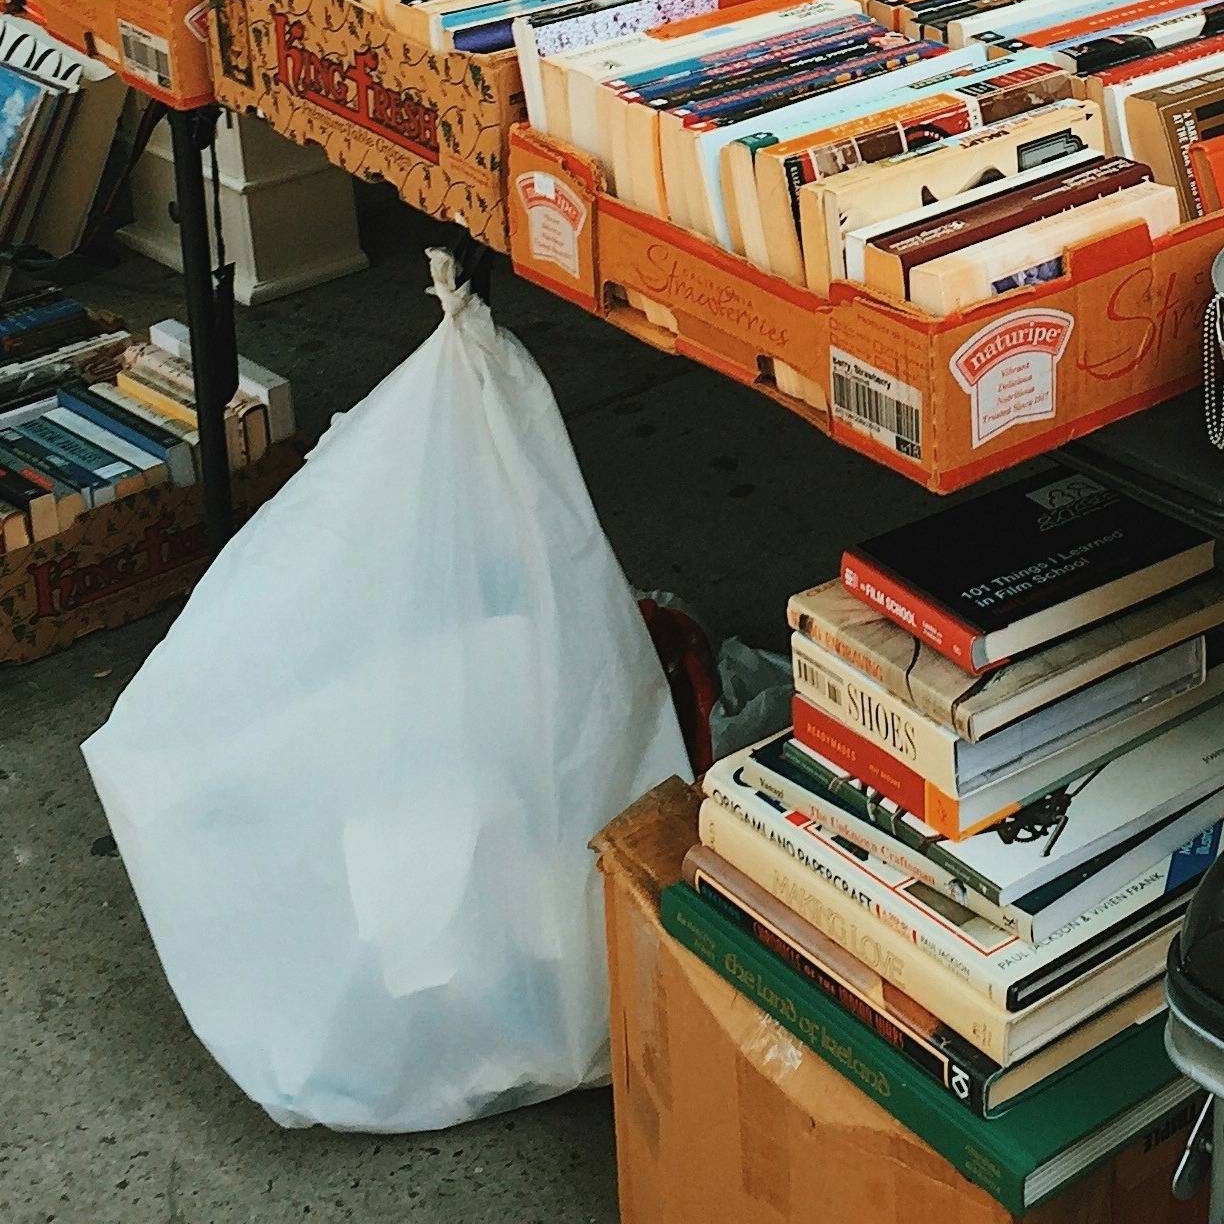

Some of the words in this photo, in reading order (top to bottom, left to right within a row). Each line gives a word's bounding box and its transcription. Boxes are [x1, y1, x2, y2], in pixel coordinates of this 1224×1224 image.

[970, 321, 1062, 370] naturipe
[961, 584, 991, 600] 101
[991, 560, 1049, 588] Things
[1057, 528, 1125, 561] Learned
[975, 596, 995, 609] in
[994, 581, 1034, 601] Film
[1032, 557, 1091, 584] School
[846, 680, 917, 762] SHOES
[712, 788, 769, 841] ORIGAMI
[768, 829, 796, 859] AND
[808, 803, 829, 823] The
[997, 948, 1033, 971] PAUL
[1032, 919, 1081, 957] JACKSON
[1091, 891, 1128, 917] VIVIEN
[1127, 870, 1167, 899] FRANK
